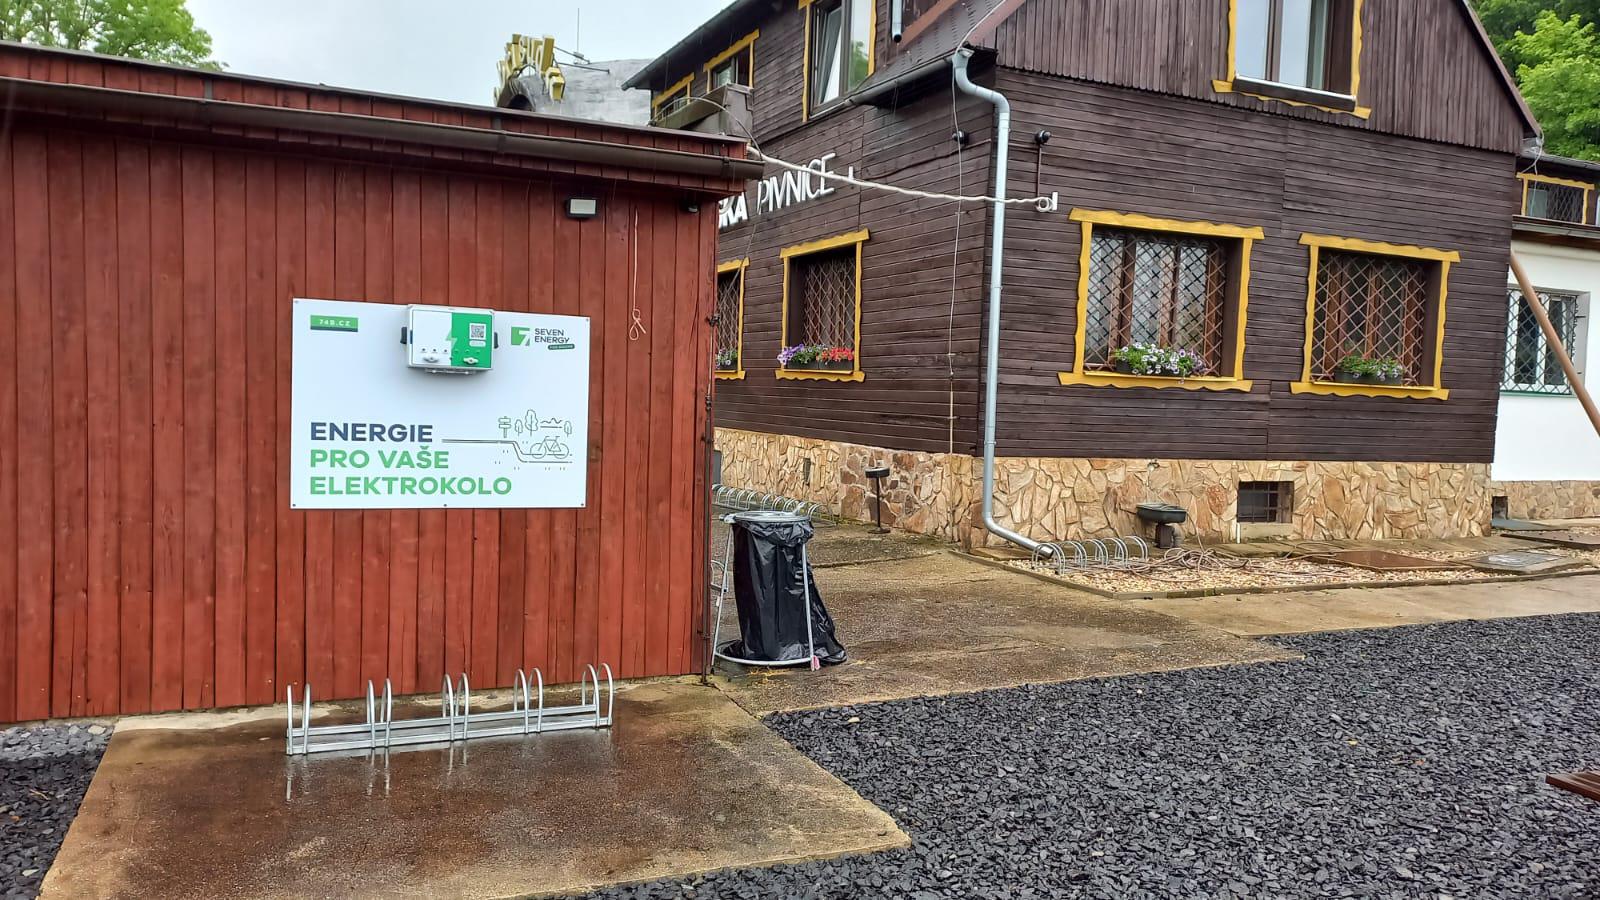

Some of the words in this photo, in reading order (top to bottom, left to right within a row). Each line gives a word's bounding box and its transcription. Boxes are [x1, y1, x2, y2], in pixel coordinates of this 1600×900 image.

[757, 152, 836, 215] PIVNICE
[534, 327, 564, 337] SEVEN
[534, 336, 570, 344] ENERGY
[311, 422, 433, 442] ENERGIE
[310, 449, 370, 469] PRO
[378, 445, 449, 469] VAŠE
[310, 477, 512, 495] ELEKTROKOLO
